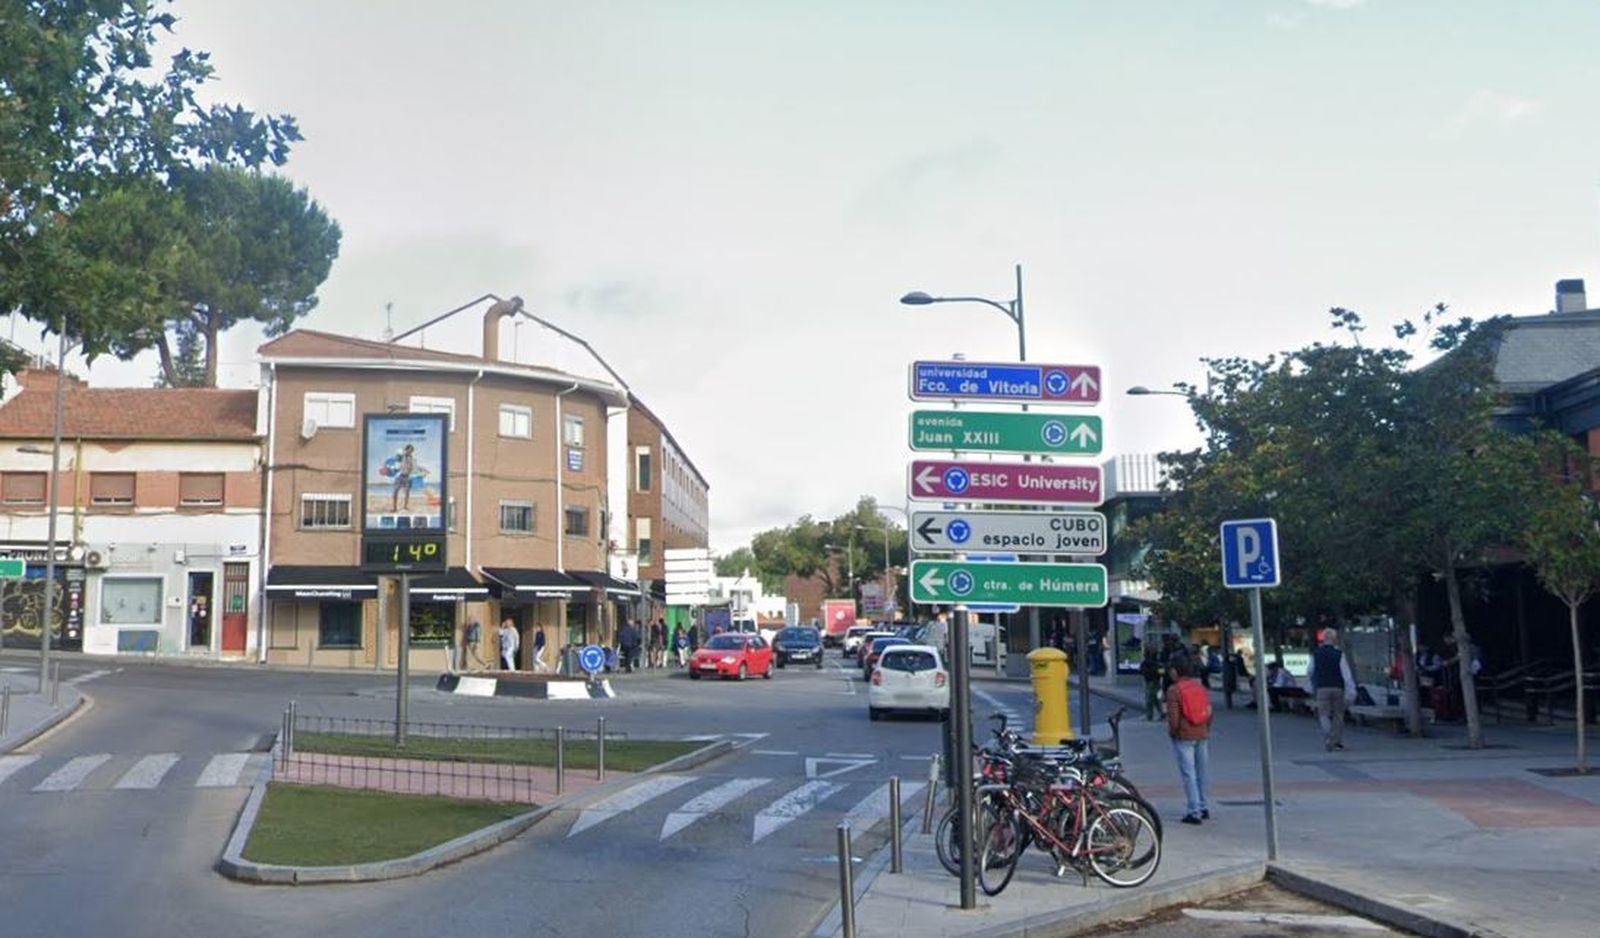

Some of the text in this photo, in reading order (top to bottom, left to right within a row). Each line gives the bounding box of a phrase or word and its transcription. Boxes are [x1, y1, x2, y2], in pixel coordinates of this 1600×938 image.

[919, 367, 988, 379] universidad
[919, 379, 1039, 395] Fco. de Vitoria
[917, 417, 964, 428] avenida
[917, 431, 999, 444] Juan XXIII
[970, 473, 1098, 493] ESIC University
[1049, 518, 1100, 532] CUBO
[983, 533, 1100, 549] espacio joven
[1236, 527, 1261, 578] P
[983, 578, 1099, 592] ctra. de Húmera
